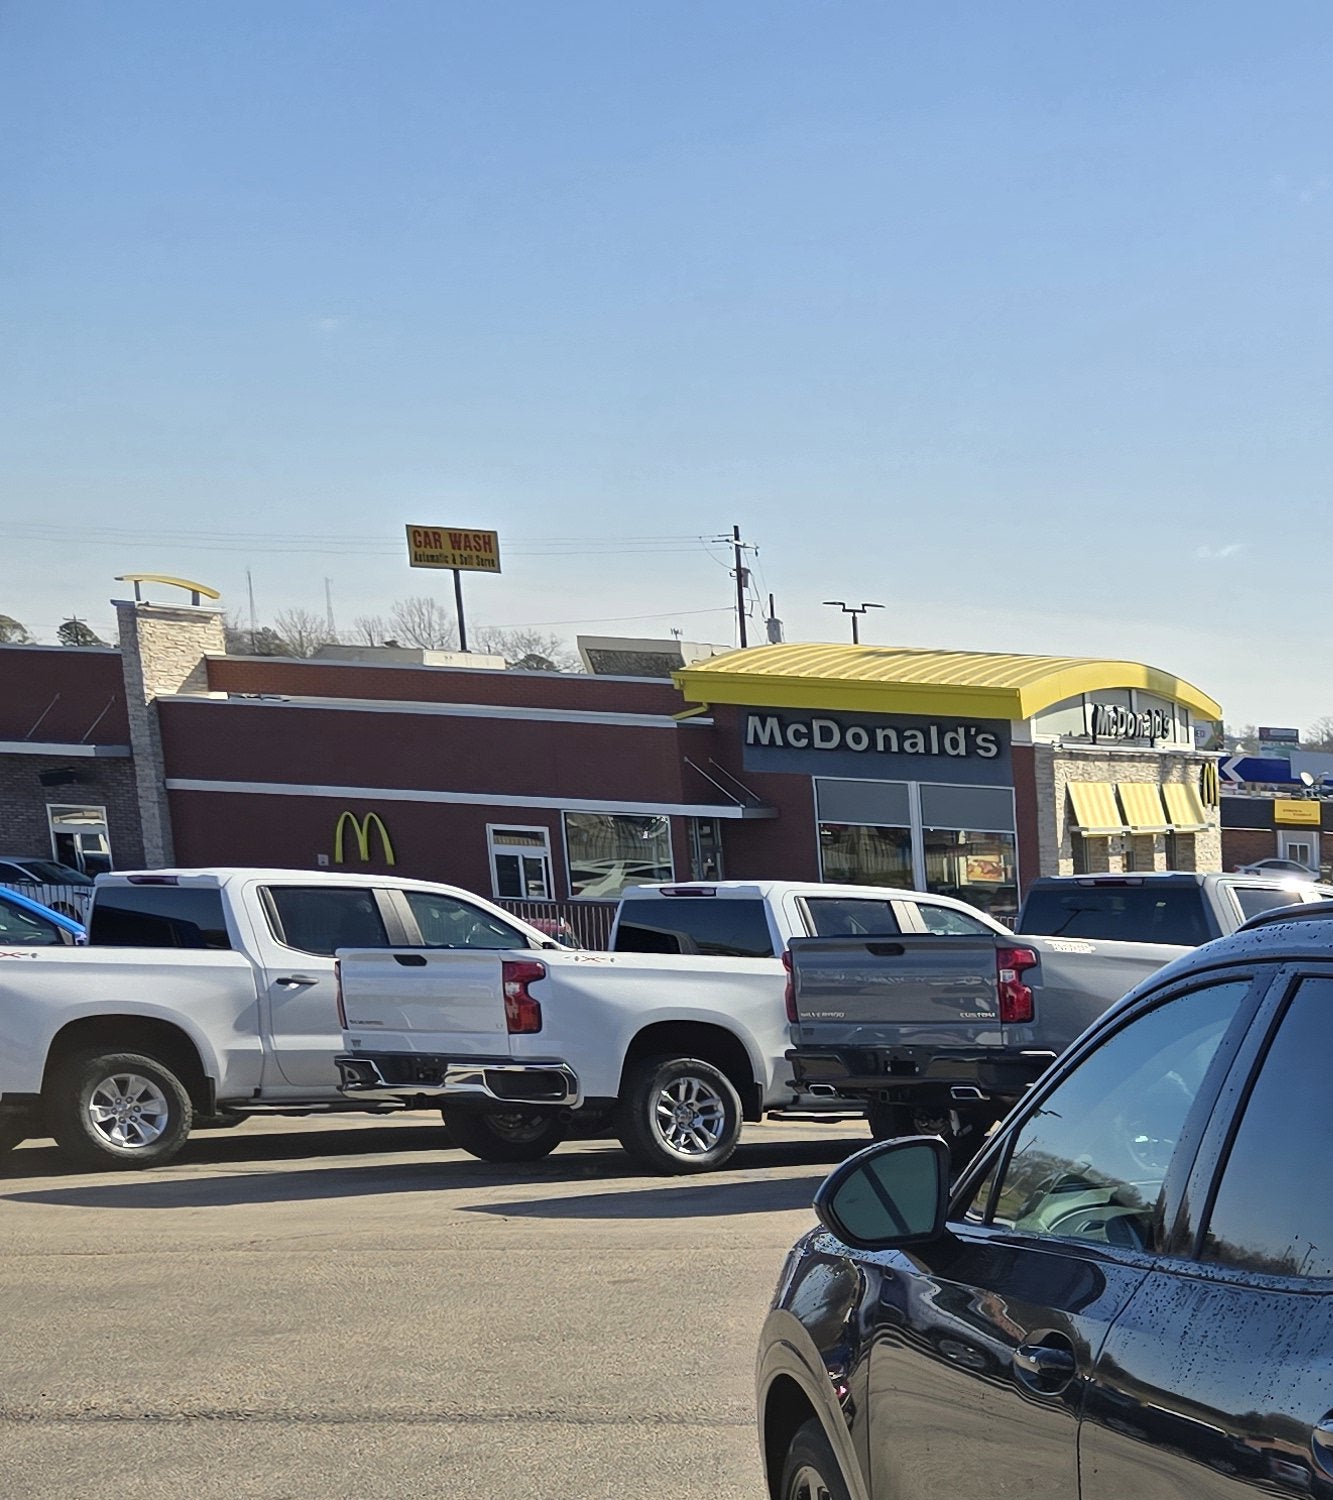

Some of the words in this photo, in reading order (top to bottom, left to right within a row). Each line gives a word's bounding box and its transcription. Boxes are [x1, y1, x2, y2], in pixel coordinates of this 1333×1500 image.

[412, 529, 443, 550] CAR
[448, 532, 493, 554] WASH
[476, 555, 496, 568] Serve
[746, 715, 998, 759] McDonald's
[1094, 703, 1171, 740] McDonald's
